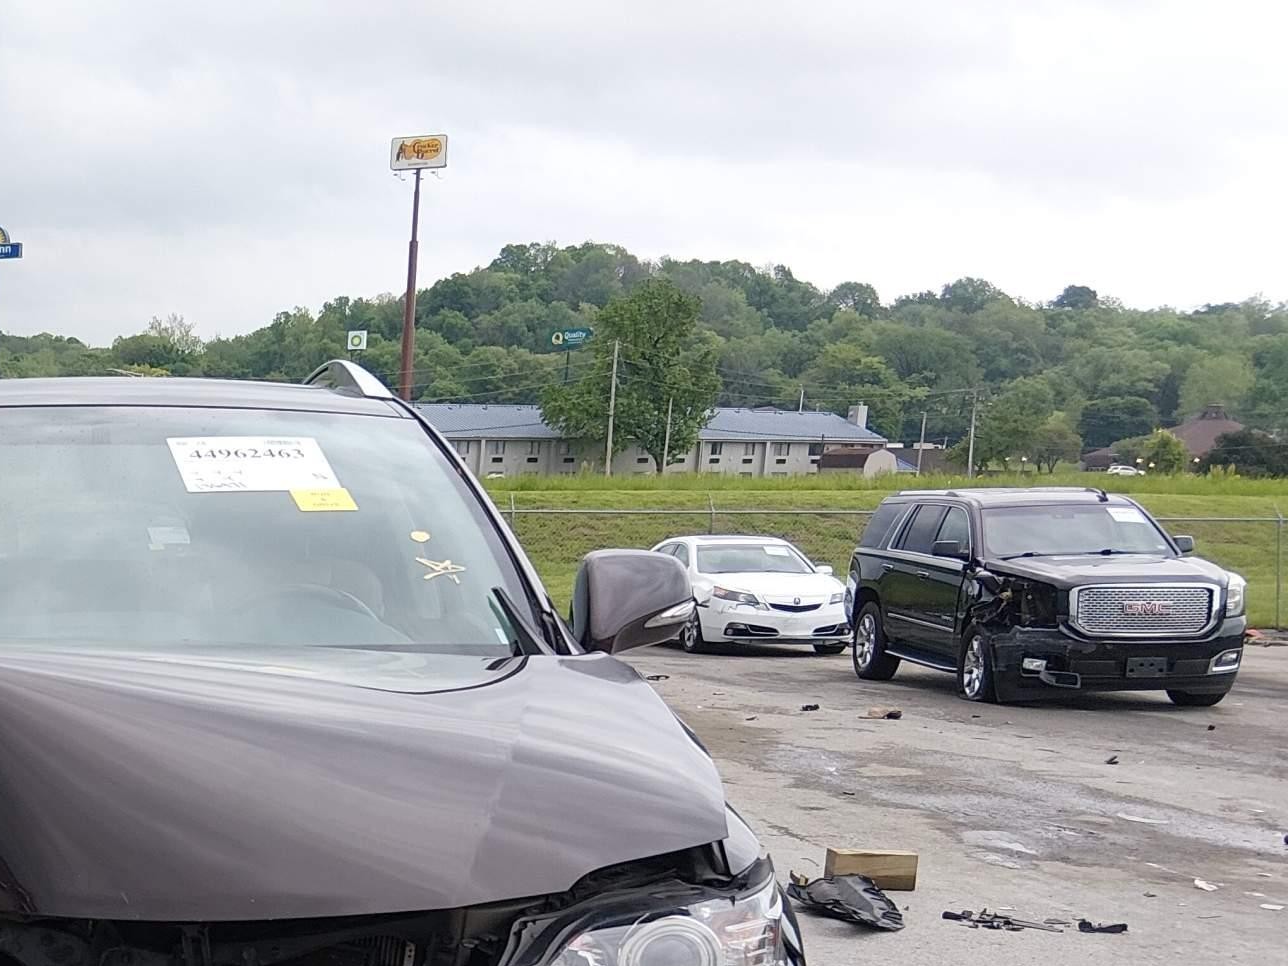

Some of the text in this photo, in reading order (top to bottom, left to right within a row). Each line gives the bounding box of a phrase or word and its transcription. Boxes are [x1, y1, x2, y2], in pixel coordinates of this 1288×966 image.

[564, 330, 587, 341] Quality
[189, 448, 305, 460] 44962463
[1123, 601, 1173, 615] GMC
